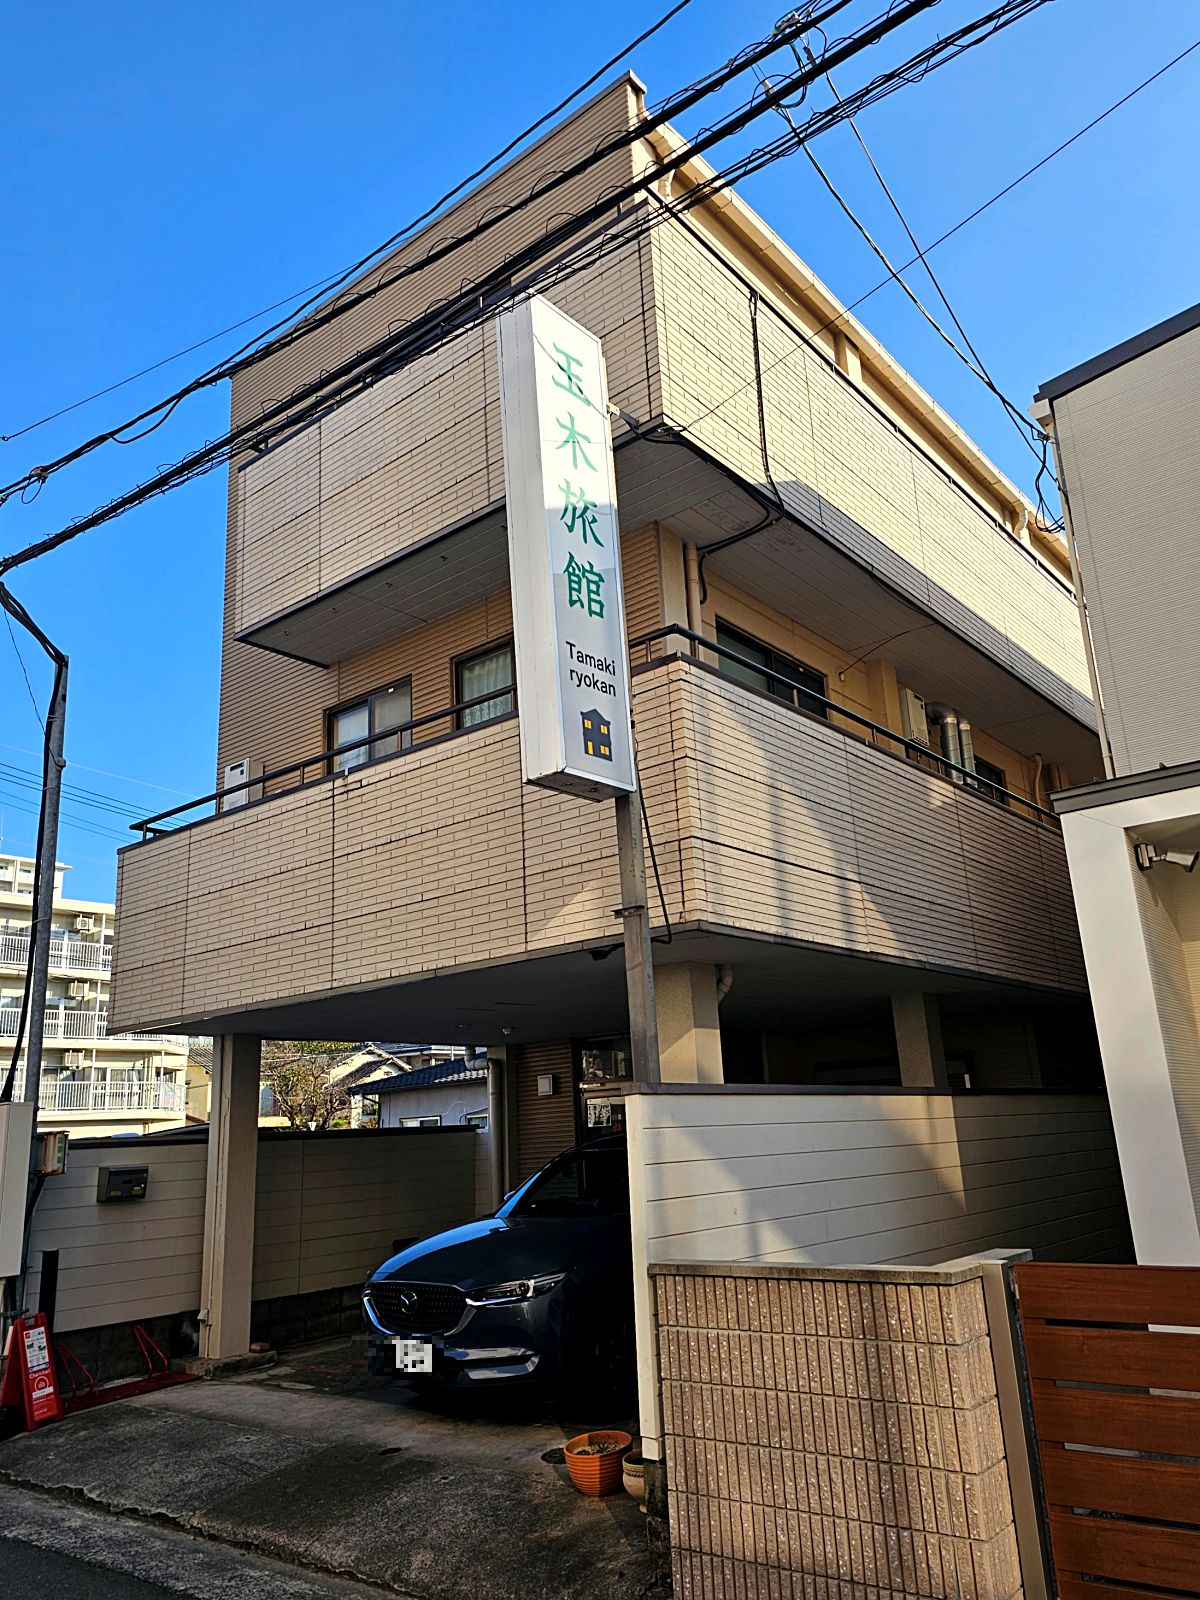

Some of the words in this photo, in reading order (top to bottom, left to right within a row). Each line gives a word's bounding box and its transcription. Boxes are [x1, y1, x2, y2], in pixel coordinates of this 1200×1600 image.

[551, 341, 605, 620] 玉木旅館
[565, 640, 616, 677] Tamaki
[569, 669, 616, 698] ryokan
